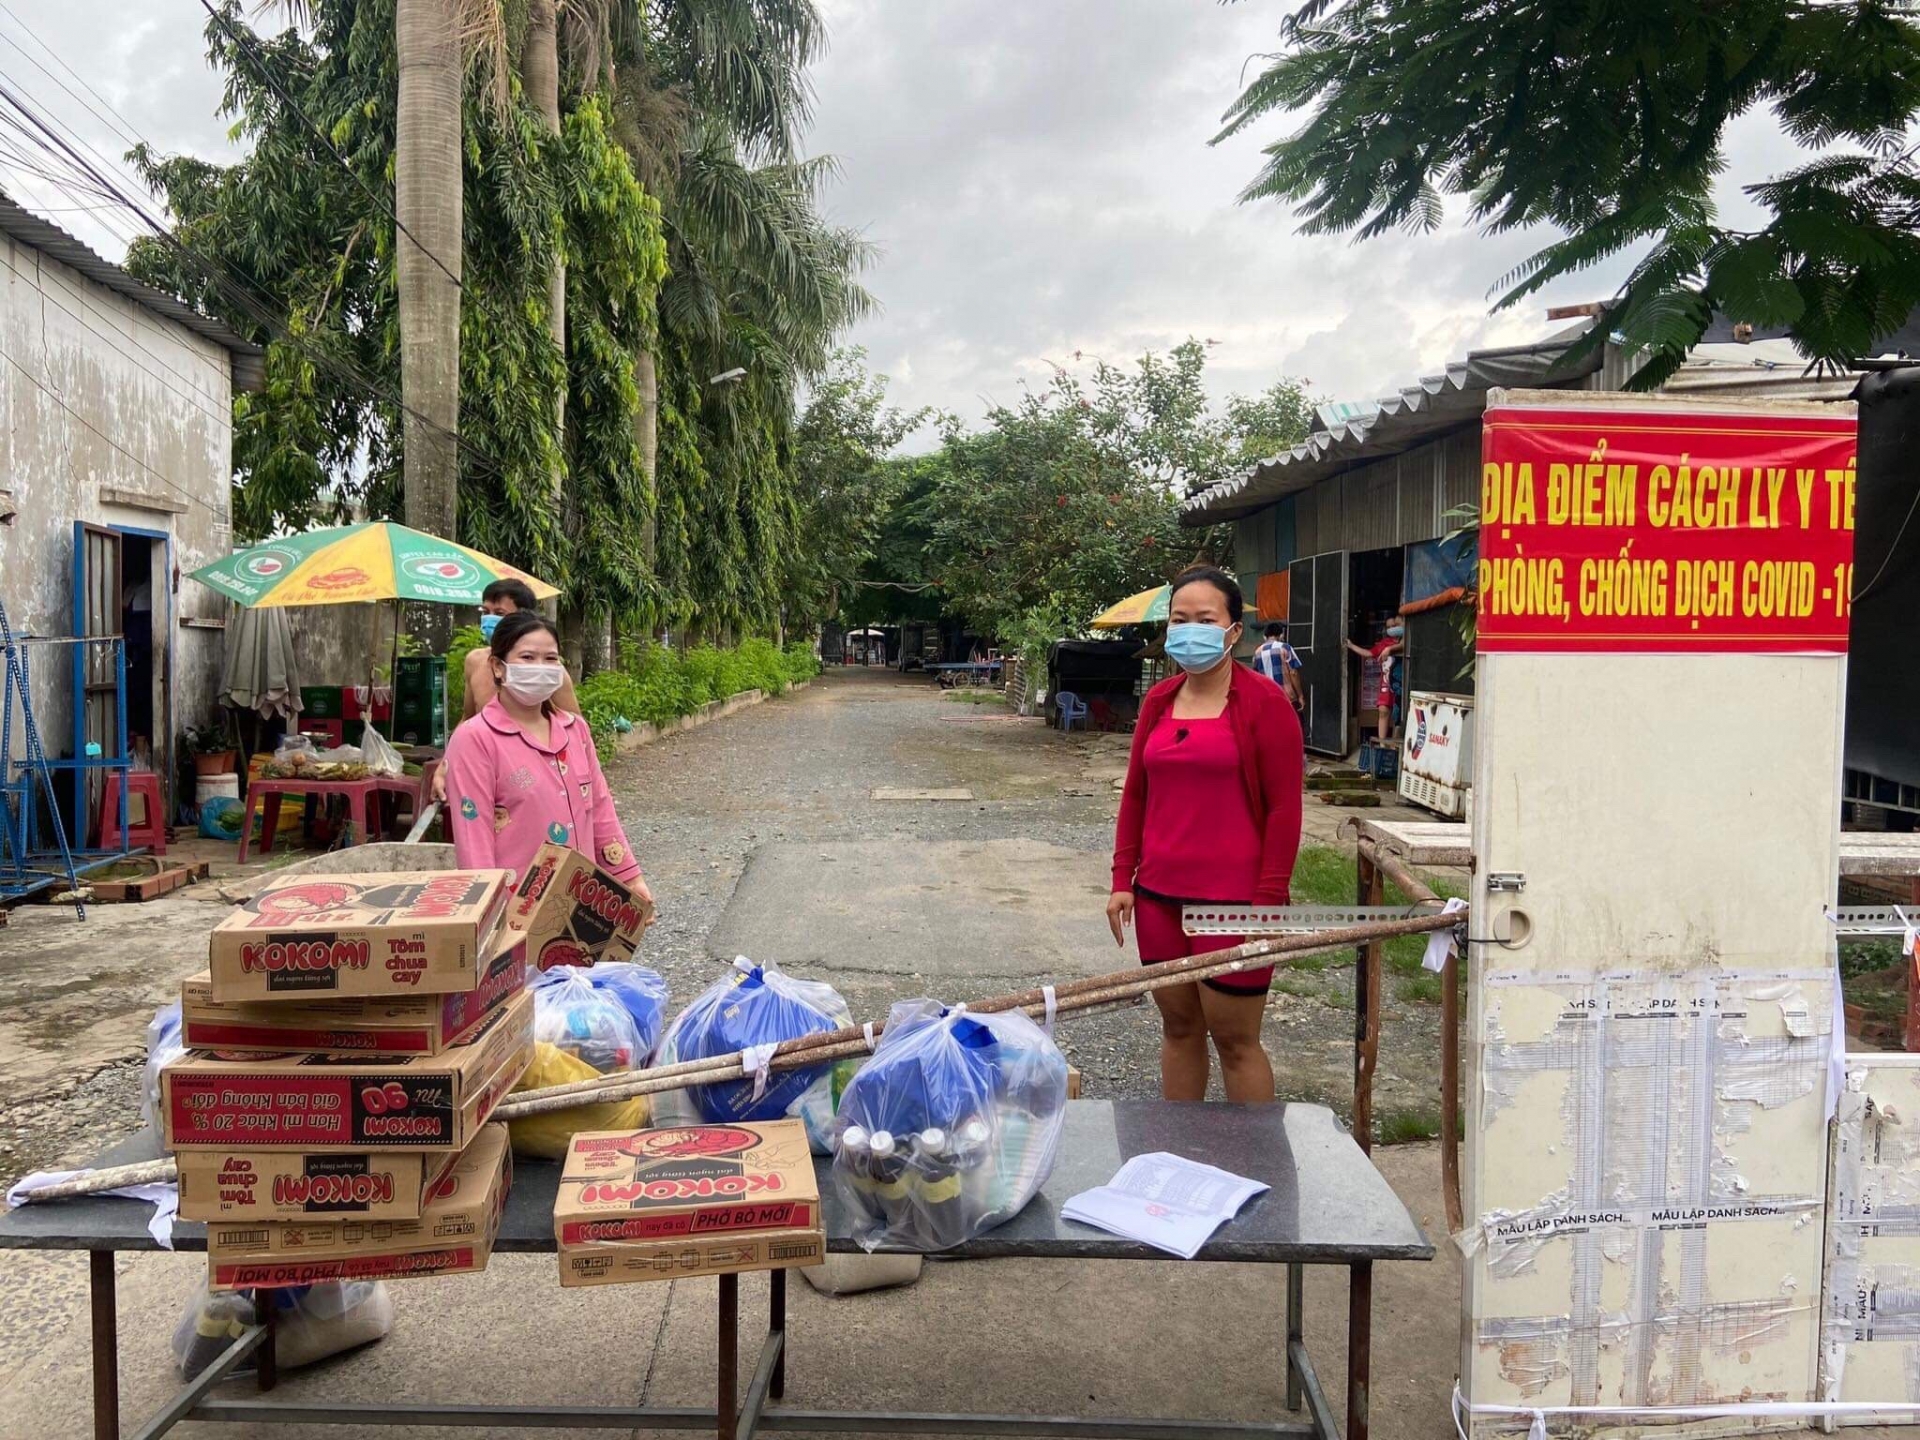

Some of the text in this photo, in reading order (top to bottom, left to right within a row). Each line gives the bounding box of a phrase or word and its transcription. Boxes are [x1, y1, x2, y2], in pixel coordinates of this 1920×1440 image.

[1481, 462, 1536, 539] ĐỊA
[1546, 438, 1638, 527] ĐIỂM
[1648, 453, 1741, 529] CÁCH
[1748, 468, 1787, 529] LY
[1795, 468, 1815, 530] Y
[1479, 544, 1570, 623] PHÒNG,
[1579, 538, 1668, 617] CHỐNG
[1675, 560, 1735, 630] DỊCH
[1742, 560, 1816, 618] COVID
[1429, 733, 1450, 747] SANAKY
[517, 856, 557, 915] KOKOMI
[566, 867, 643, 937] KOKOMI
[412, 932, 425, 940] mì
[240, 938, 370, 973] KOKOMI
[386, 938, 426, 954] Tôm
[385, 956, 428, 970] chua
[391, 970, 422, 986] cay
[316, 1032, 377, 1049] KOKOMI
[221, 1090, 272, 1112] không
[275, 1093, 308, 1112] bán
[311, 1093, 342, 1112] Giá
[361, 1081, 409, 1114] 90
[213, 1114, 235, 1131] 20
[238, 1114, 278, 1132] khác
[283, 1114, 304, 1132] mì
[308, 1114, 342, 1131] Hơn
[363, 1116, 442, 1135] KOKOMI
[223, 1157, 252, 1173] cay
[217, 1173, 258, 1189] chua
[272, 1173, 395, 1206] KOKOMI
[579, 1172, 784, 1205] KOKOMI
[219, 1189, 256, 1205] Tôm
[578, 1220, 643, 1240] KOKOMI
[697, 1208, 733, 1228] PHỞ
[734, 1207, 756, 1225] BÒ
[759, 1205, 791, 1223] MỚI
[1527, 1219, 1551, 1235] LẬP
[1554, 1214, 1587, 1229] DANH
[1682, 1208, 1705, 1223] LẬP
[1707, 1207, 1742, 1219] DANH
[394, 1251, 458, 1270] KOKOMI
